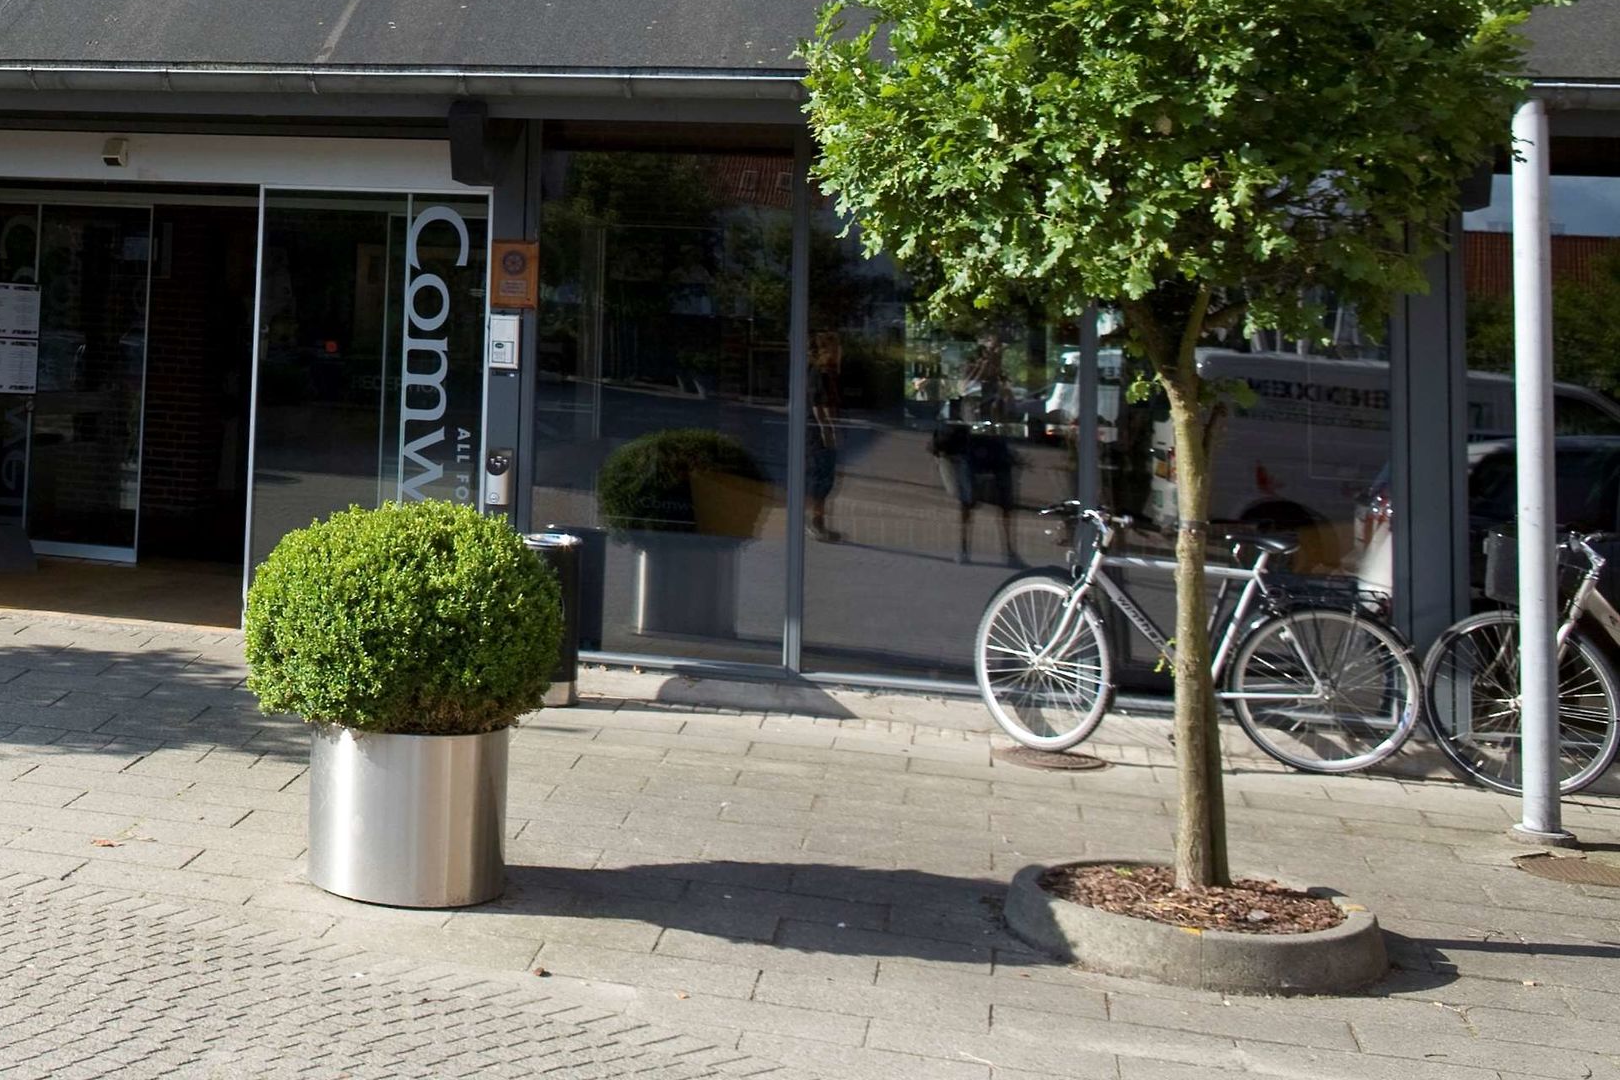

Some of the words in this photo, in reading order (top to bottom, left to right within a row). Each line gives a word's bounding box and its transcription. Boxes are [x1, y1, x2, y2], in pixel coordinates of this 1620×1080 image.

[402, 206, 469, 503] Comw
[457, 427, 471, 463] ALL
[455, 474, 470, 500] FO
